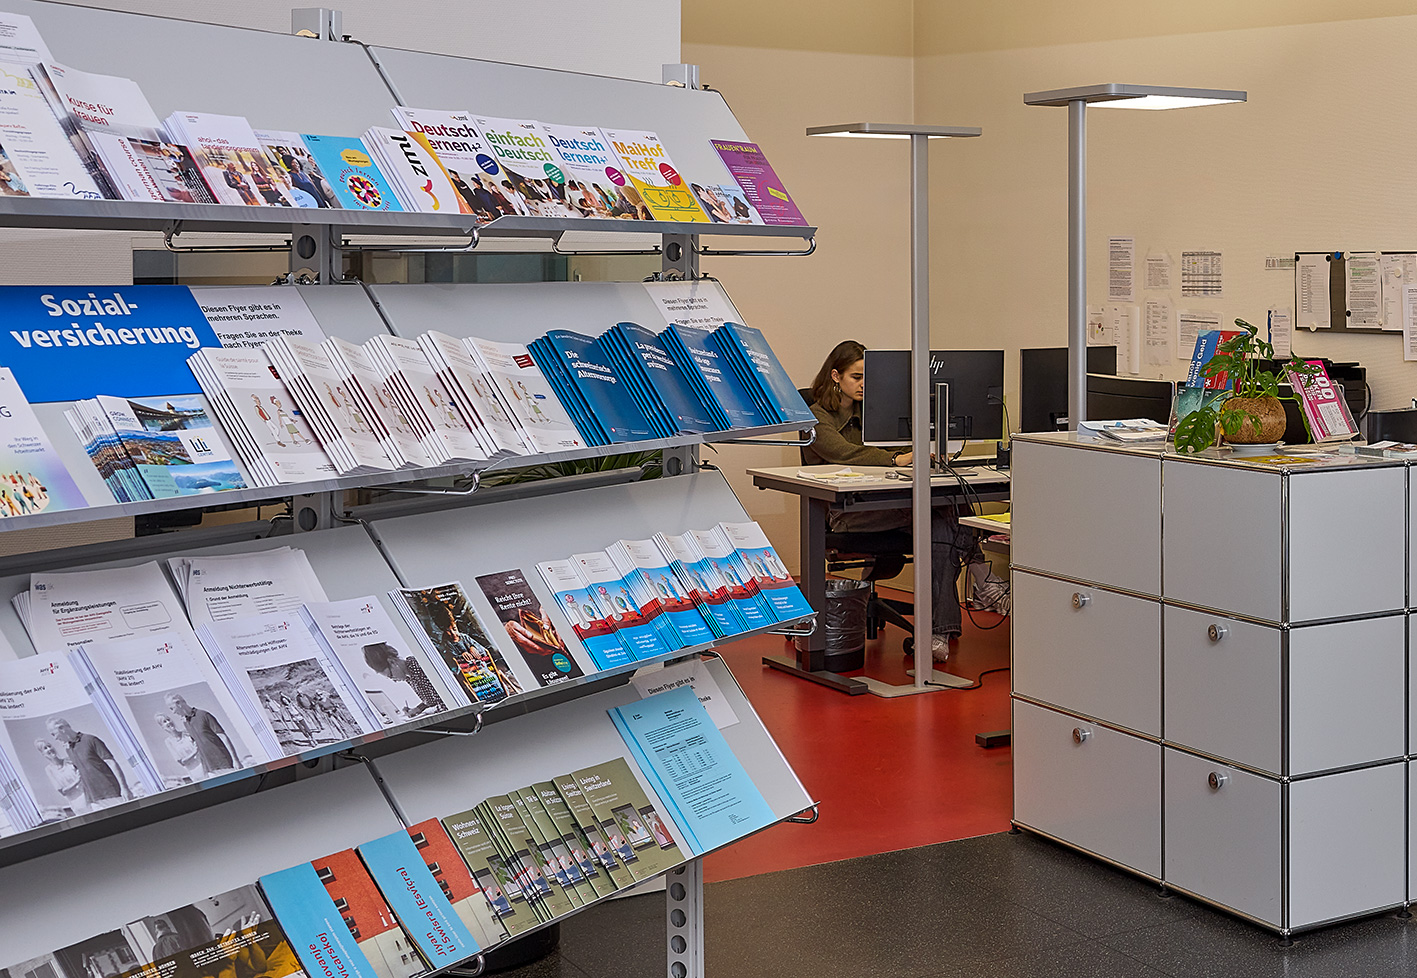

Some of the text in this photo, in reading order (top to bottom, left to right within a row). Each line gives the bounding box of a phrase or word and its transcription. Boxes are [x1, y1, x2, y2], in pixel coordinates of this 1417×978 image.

[66, 94, 114, 116] kurse für
[72, 107, 109, 126] frauen
[411, 120, 478, 138] Deutsch
[485, 129, 546, 148] einfach
[548, 135, 606, 152] Deutsch
[493, 145, 554, 162] Deutsch
[612, 141, 665, 158] MaiHof
[621, 156, 659, 171] Treff
[40, 292, 139, 317] Sozial-
[677, 297, 689, 305] Flyer
[201, 304, 228, 313] Diesen
[228, 304, 247, 313] Flyer
[248, 304, 263, 313] gibt
[207, 312, 280, 322] mehreren Sprachen.
[9, 323, 201, 349] versicherung
[217, 331, 244, 341] Fragen
[245, 331, 257, 339] Sie
[268, 330, 280, 338] der
[280, 329, 303, 337] Theke
[223, 340, 242, 349] nach
[565, 351, 579, 359] Die
[929, 354, 945, 375] hp
[1191, 339, 1208, 388] wenig Geld
[203, 585, 229, 593] Anmeldung
[51, 600, 79, 608] Anmeldung
[59, 600, 117, 614] Ergänzungsleistungen
[499, 602, 517, 611] Rente
[647, 685, 664, 695] Diesen
[663, 682, 676, 691] Flyer
[675, 679, 684, 688] gibt
[579, 775, 594, 786] Living
[584, 779, 612, 793] Switzerland
[451, 820, 475, 831] Wohnen
[456, 827, 480, 840] Schweiz
[425, 931, 448, 957] Jiyan
